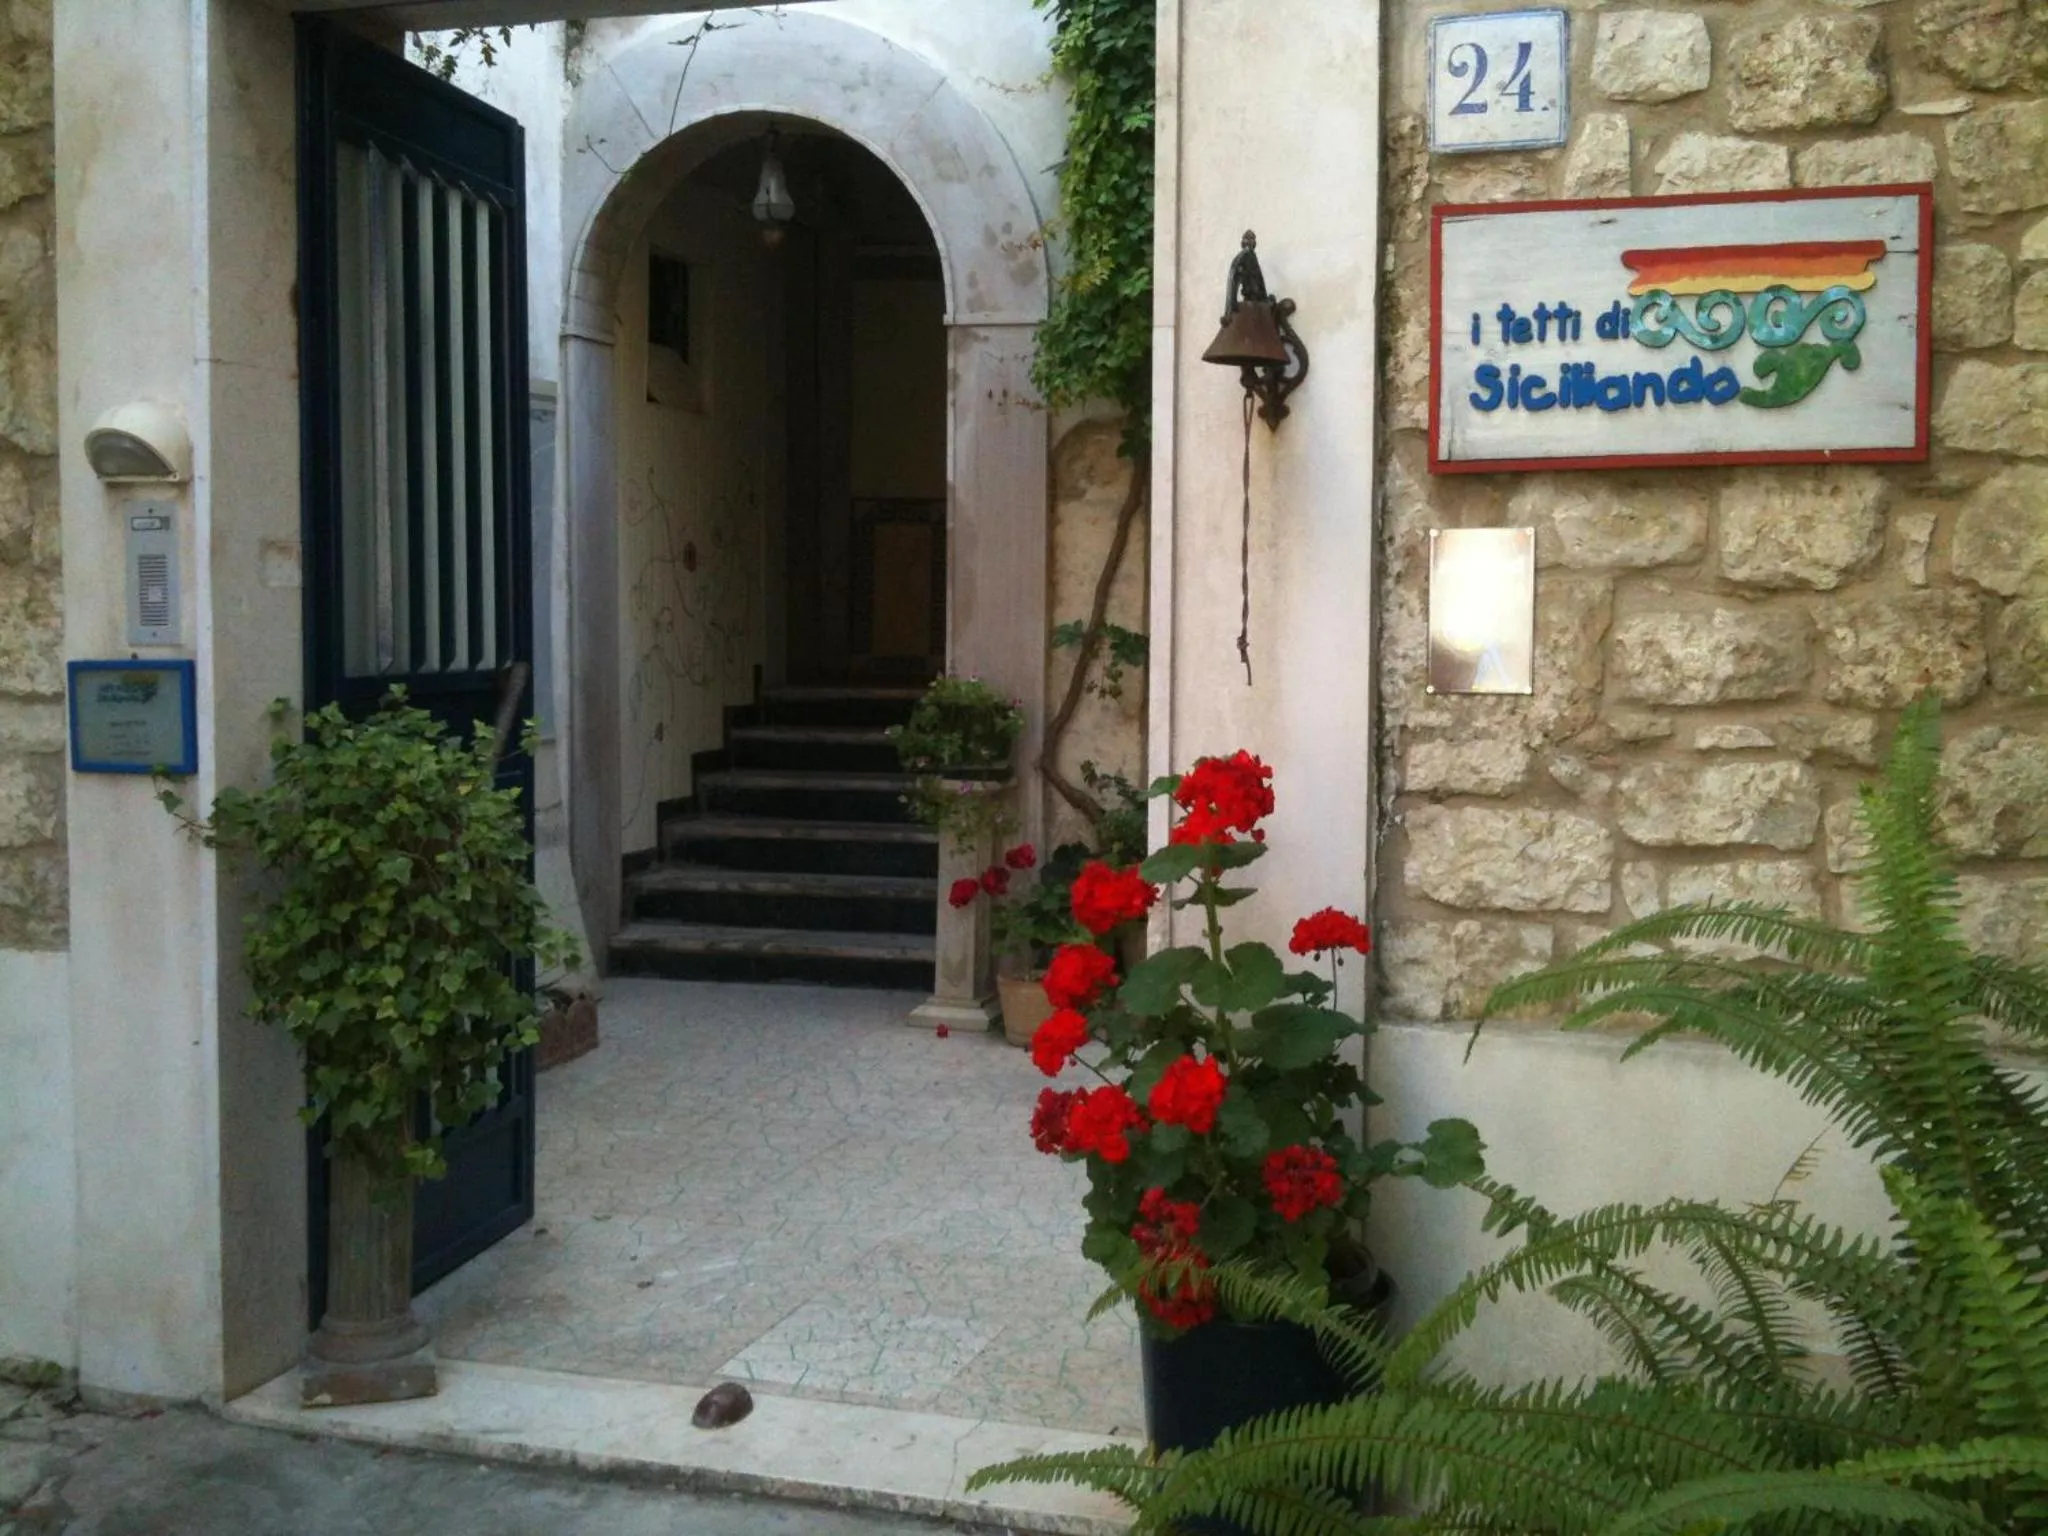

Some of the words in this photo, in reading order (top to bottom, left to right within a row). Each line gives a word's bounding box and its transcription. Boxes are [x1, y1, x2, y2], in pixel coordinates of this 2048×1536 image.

[1471, 312, 1481, 345] i
[1496, 300, 1582, 345] tetti
[1595, 300, 1631, 340] di
[1469, 356, 1740, 412] Siciliando
